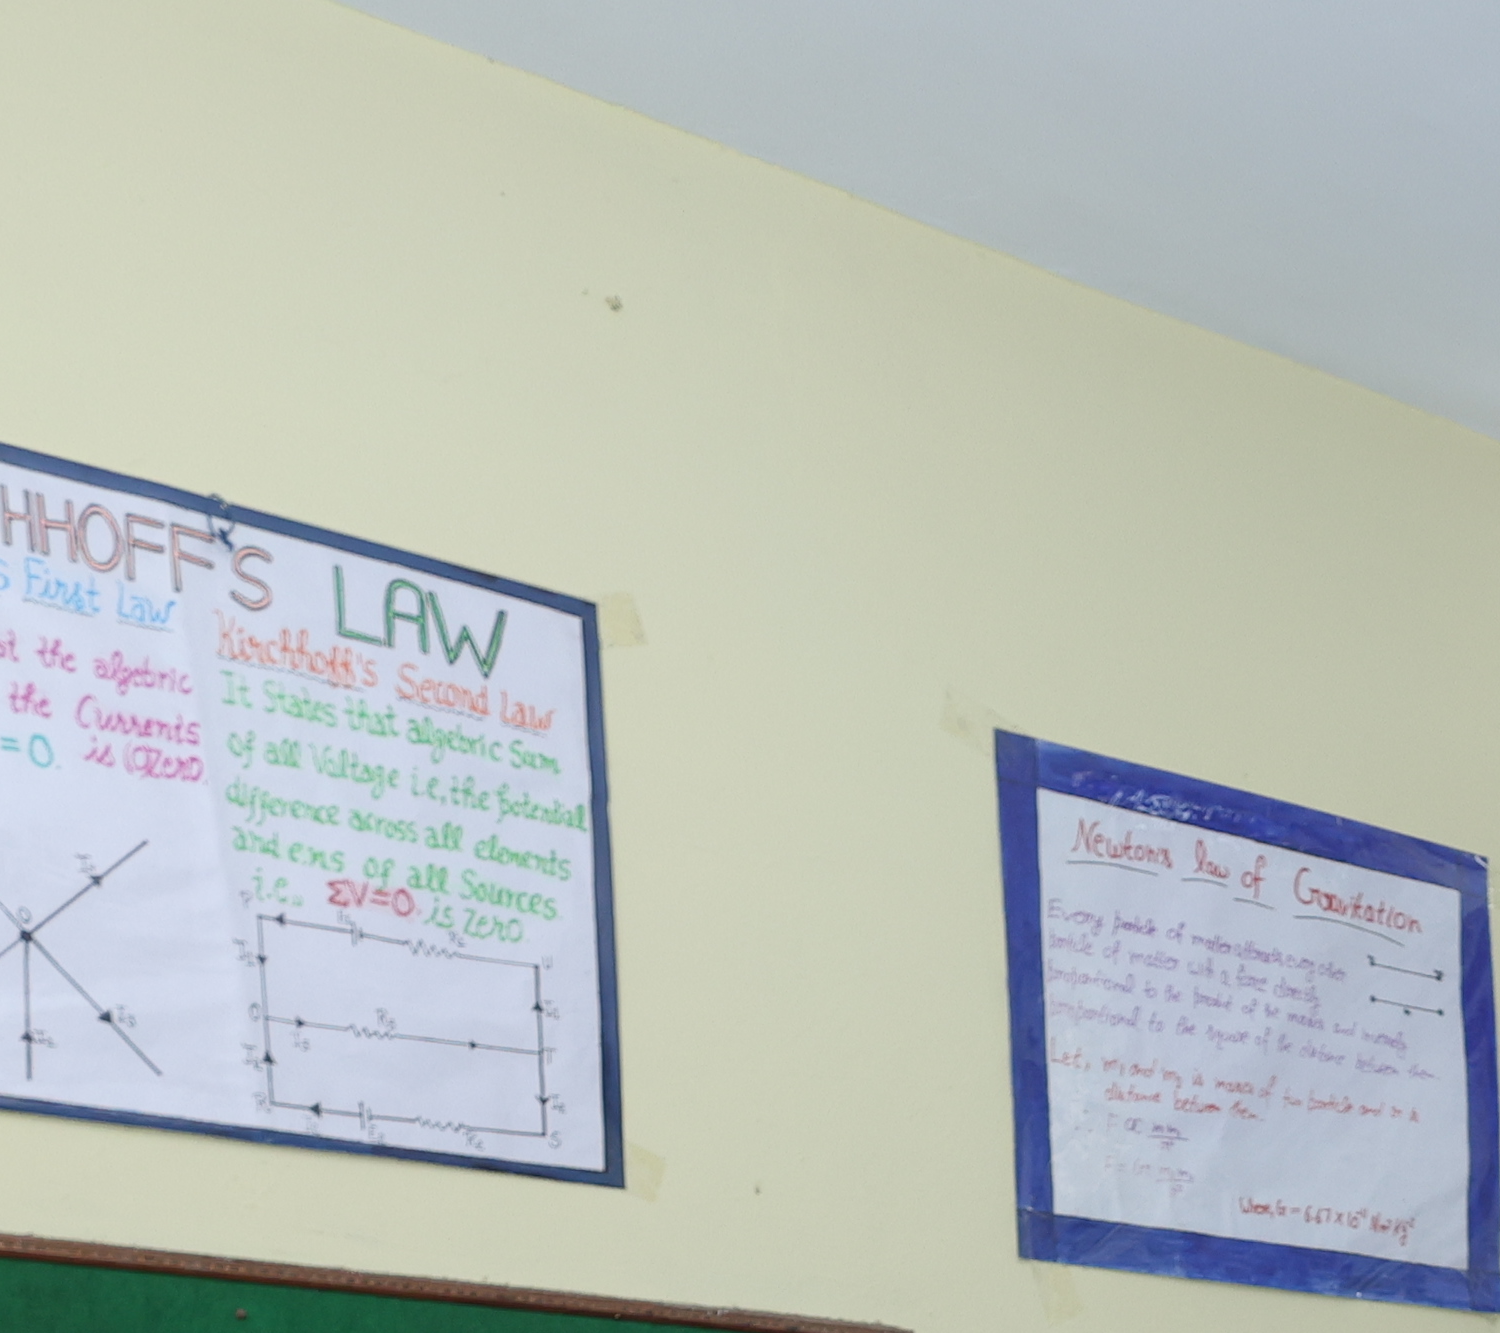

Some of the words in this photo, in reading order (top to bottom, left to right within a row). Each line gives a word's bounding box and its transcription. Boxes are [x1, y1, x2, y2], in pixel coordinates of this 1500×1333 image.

[332, 564, 508, 680] LAW
[35, 635, 77, 674] the
[8, 680, 53, 719] the
[343, 694, 400, 739] that
[263, 736, 303, 769] all
[423, 821, 465, 853] all
[361, 856, 396, 889] of
[405, 863, 450, 896] all
[1241, 855, 1268, 898] of
